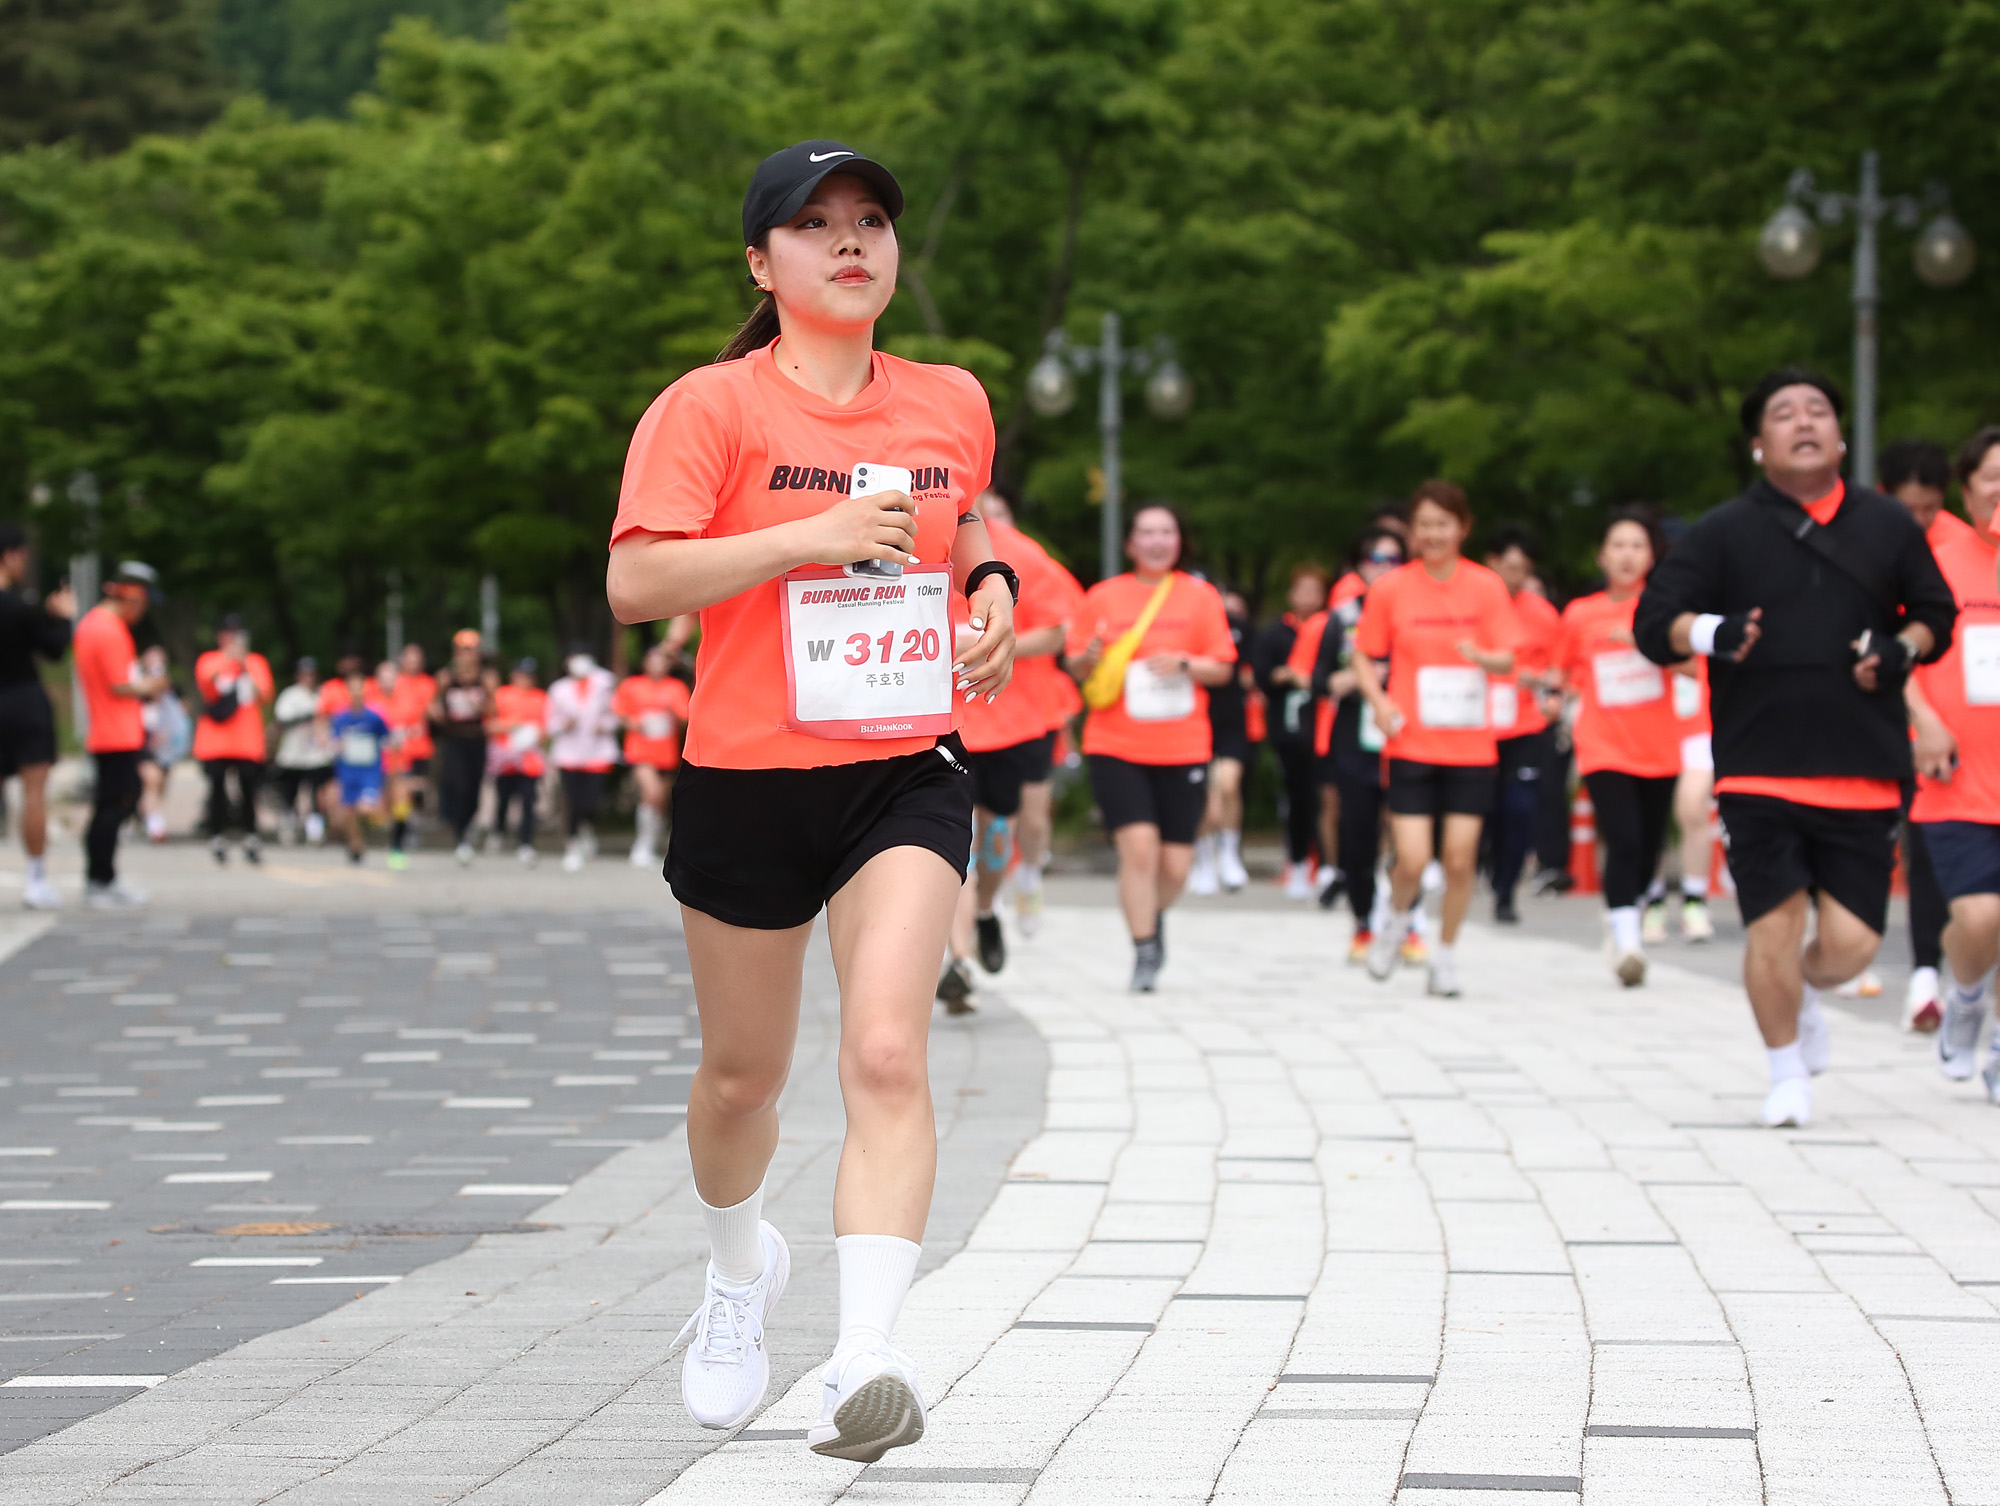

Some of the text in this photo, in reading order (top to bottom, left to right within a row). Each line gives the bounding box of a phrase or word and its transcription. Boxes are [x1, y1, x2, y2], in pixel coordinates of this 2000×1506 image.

[769, 465, 851, 495] BURNI
[800, 585, 906, 605] BURNING RUN
[916, 585, 943, 597] 10km
[858, 600, 881, 608] Running
[807, 628, 940, 666] W 3120
[865, 671, 905, 688] 주호정
